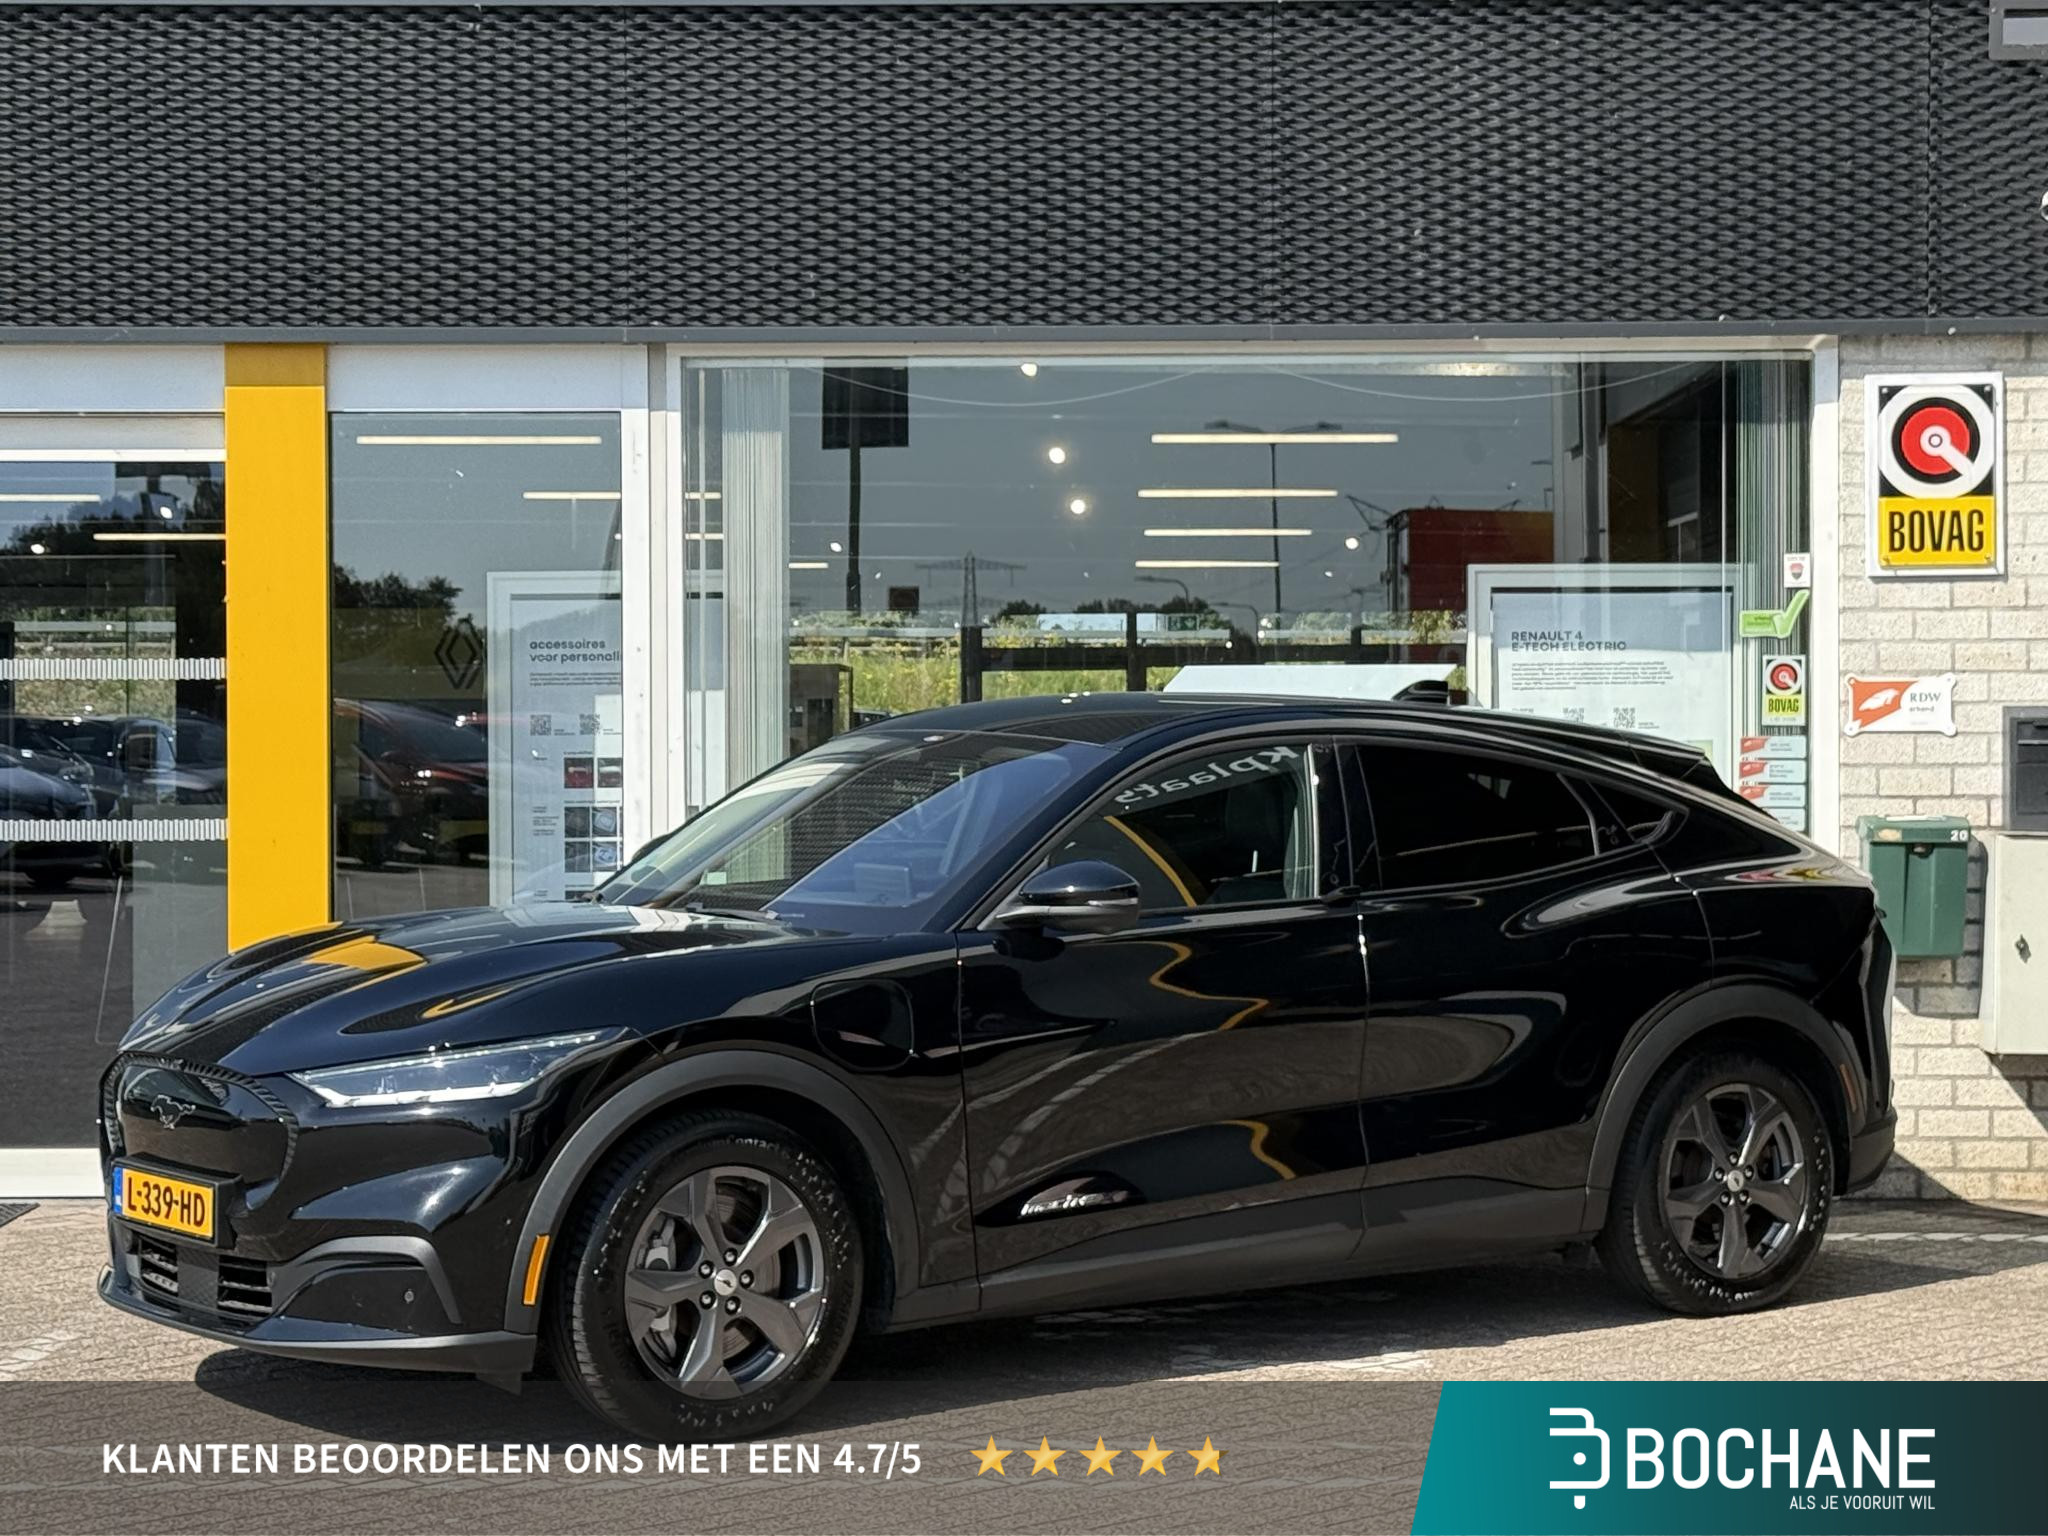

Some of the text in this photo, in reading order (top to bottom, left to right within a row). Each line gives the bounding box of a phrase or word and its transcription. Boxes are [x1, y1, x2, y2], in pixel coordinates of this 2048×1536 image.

[1888, 509, 1984, 553] BOVAG
[1511, 631, 1583, 641] RENAULT 4
[529, 638, 606, 649] accessoires
[1511, 641, 1627, 652] E-TECH ELECTRIC
[529, 652, 559, 662] voor
[1910, 692, 1941, 703] RDW
[1768, 698, 1799, 713] BOVAG
[1951, 830, 1969, 841] 20
[127, 1176, 206, 1228] L-339-HD
